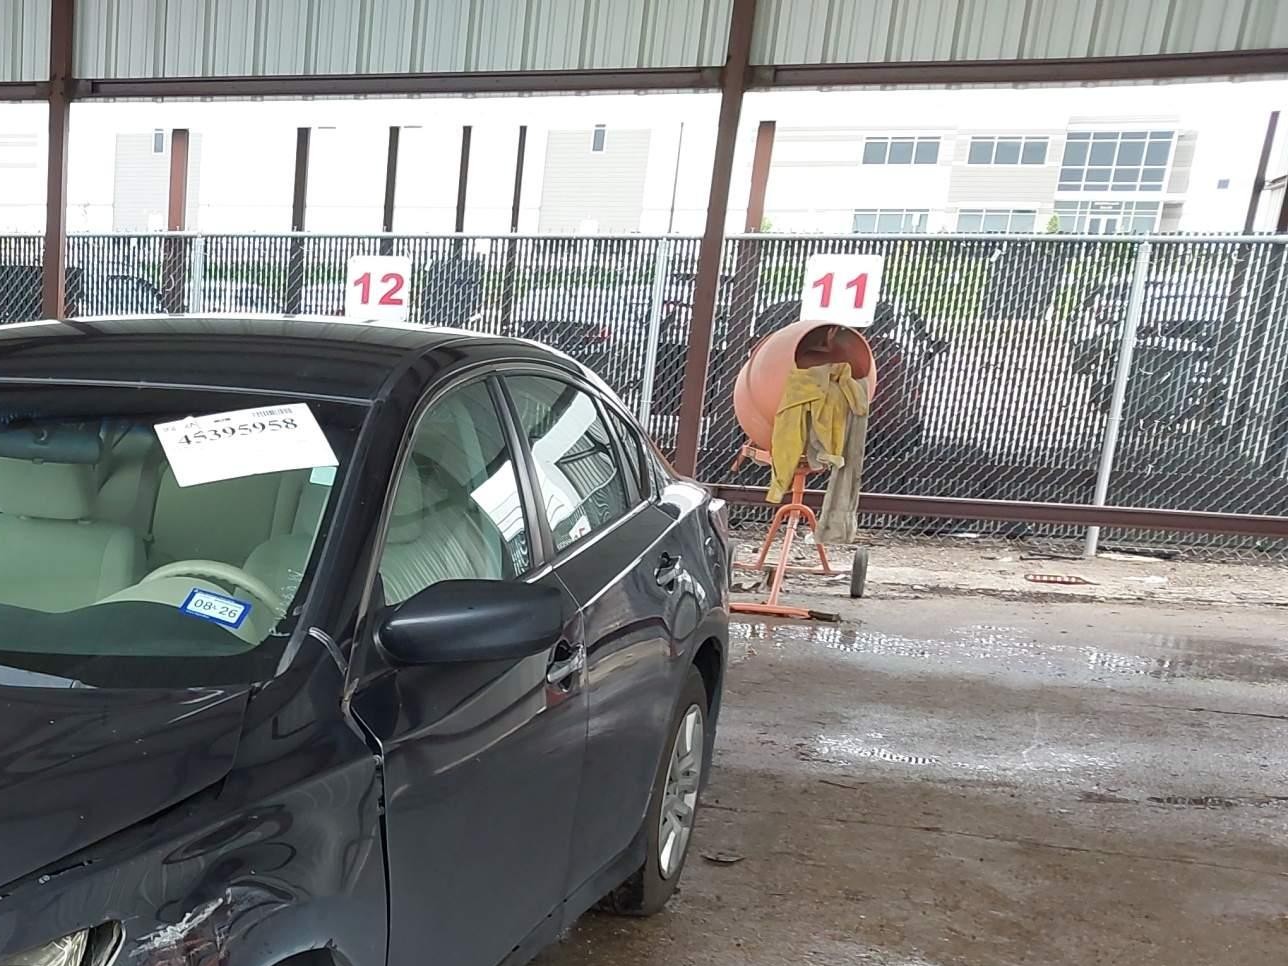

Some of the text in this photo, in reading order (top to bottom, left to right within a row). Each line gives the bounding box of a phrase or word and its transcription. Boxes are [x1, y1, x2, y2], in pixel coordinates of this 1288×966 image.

[353, 272, 405, 305] 12
[812, 272, 868, 309] 11
[177, 418, 298, 446] 45395958
